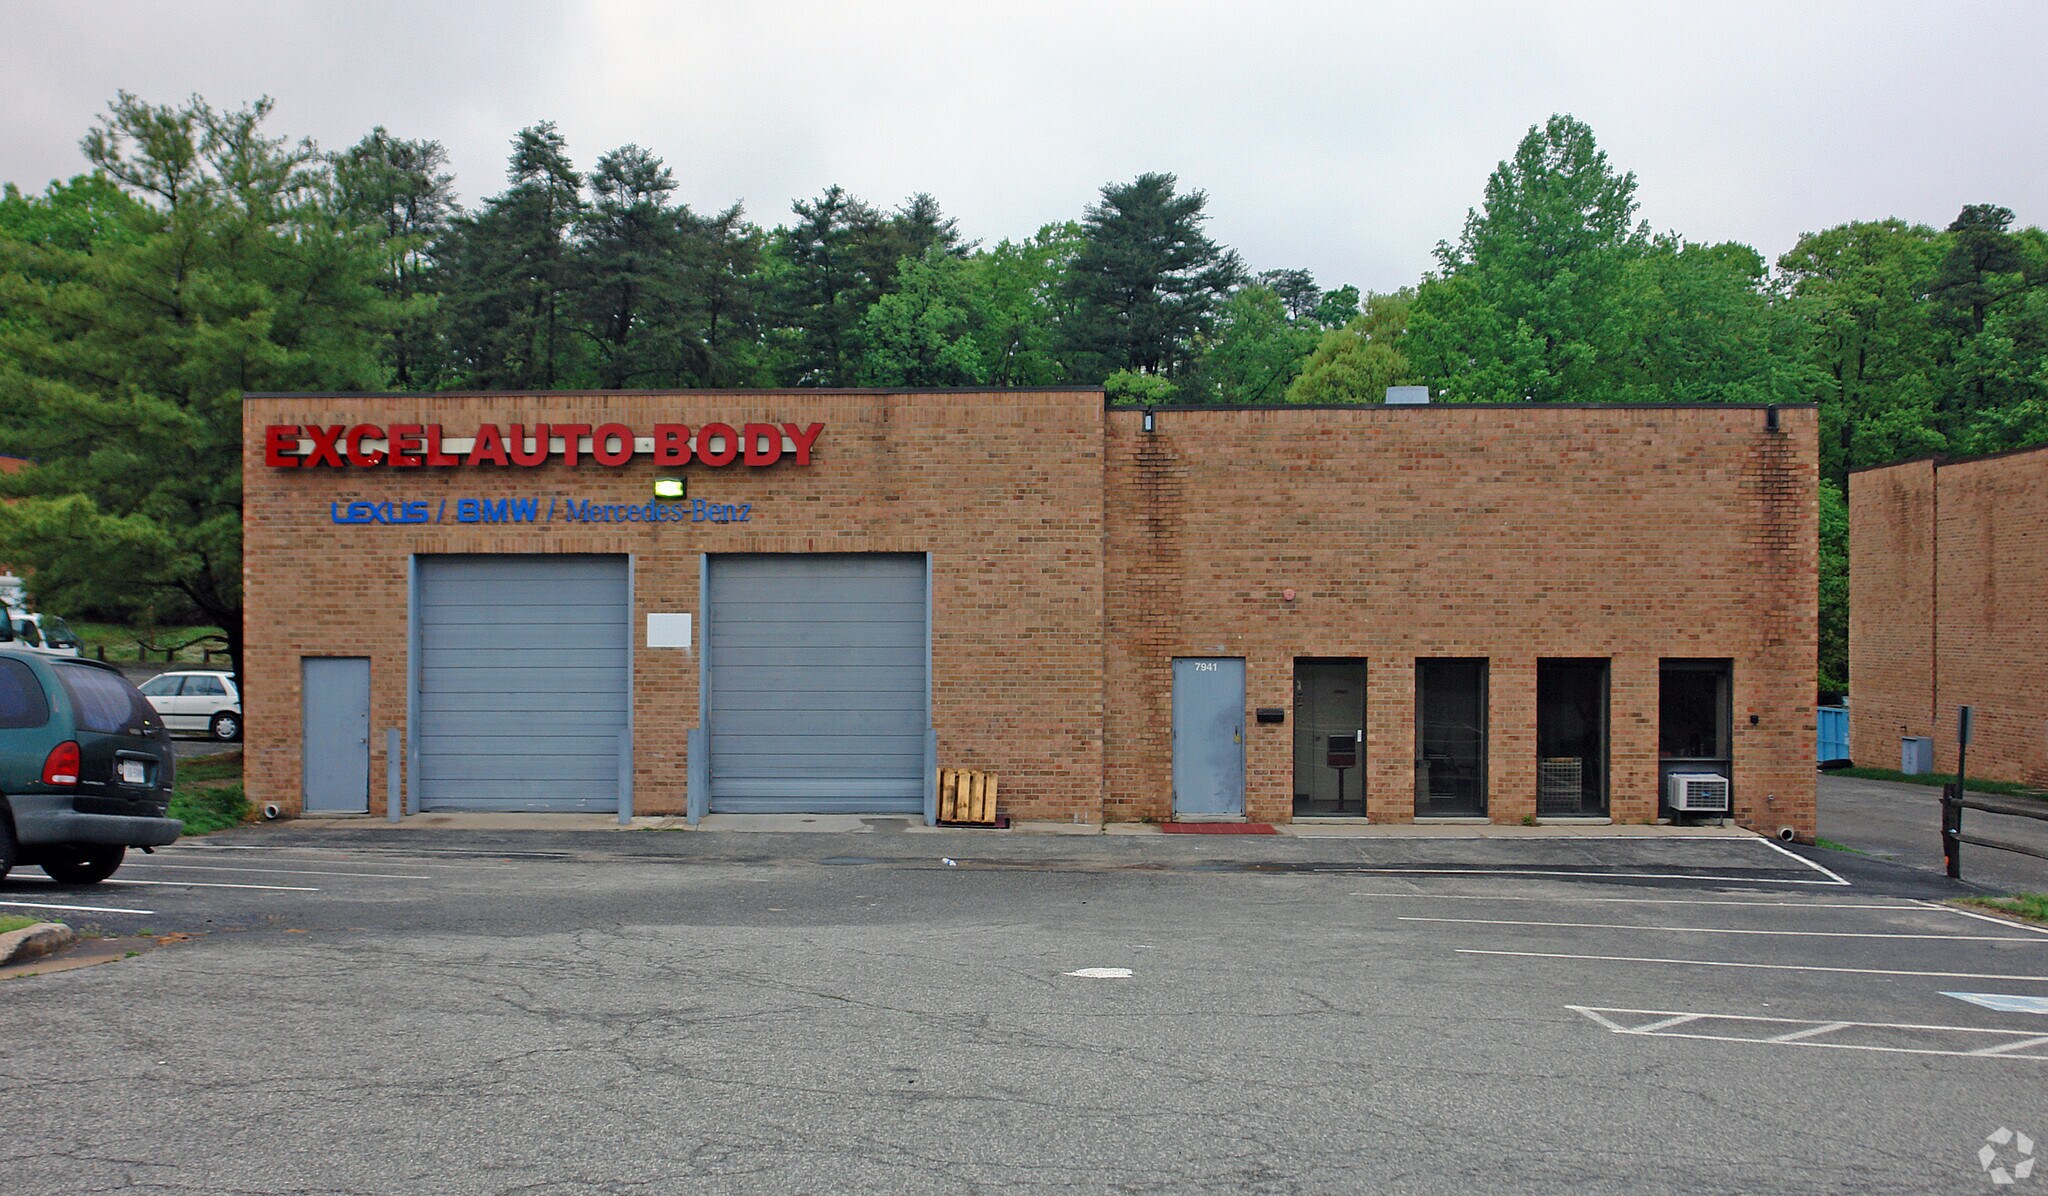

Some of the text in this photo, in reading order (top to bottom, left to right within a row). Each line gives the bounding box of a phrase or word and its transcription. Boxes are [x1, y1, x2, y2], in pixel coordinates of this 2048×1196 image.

[265, 422, 826, 468] EXCEL AUTO BODY
[331, 501, 429, 524] LEXUS
[457, 498, 539, 523] BMW
[566, 498, 752, 523] Mercedes-Benz
[1194, 662, 1218, 672] 7941
